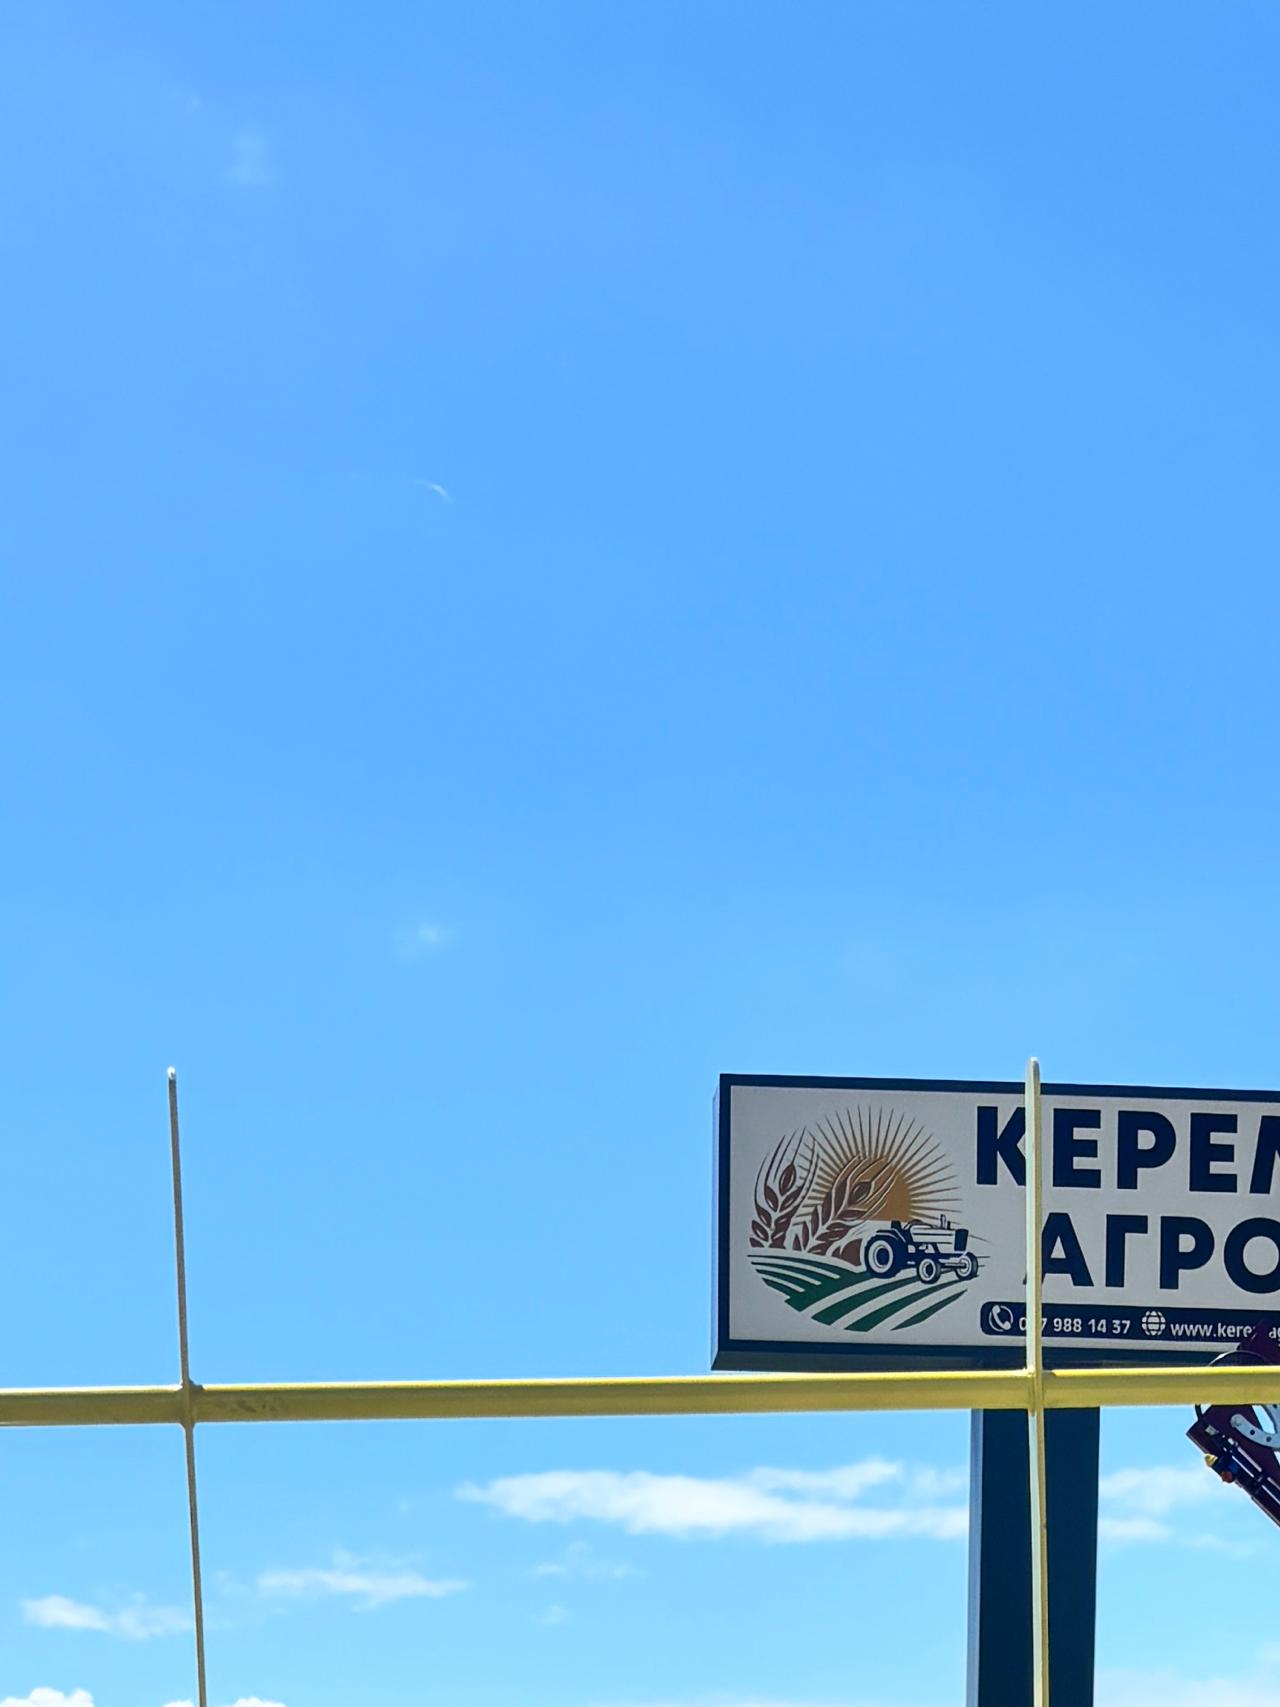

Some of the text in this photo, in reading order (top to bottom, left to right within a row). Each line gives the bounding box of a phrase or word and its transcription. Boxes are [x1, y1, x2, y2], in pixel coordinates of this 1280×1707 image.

[1019, 1316, 1047, 1331] 07
[1053, 1317, 1082, 1333] 988
[1088, 1320, 1108, 1333] 14
[1112, 1320, 1131, 1335] 37
